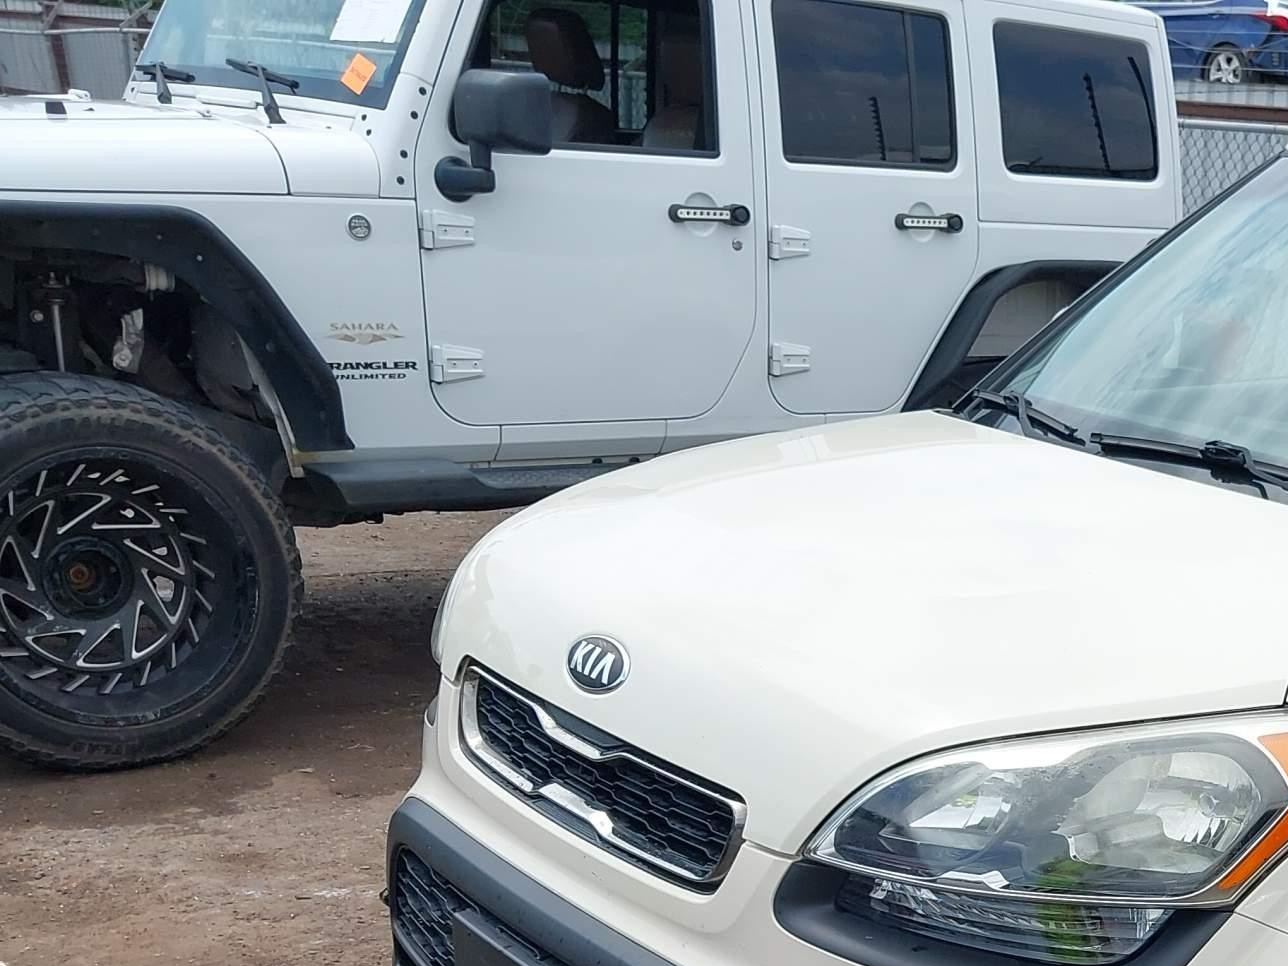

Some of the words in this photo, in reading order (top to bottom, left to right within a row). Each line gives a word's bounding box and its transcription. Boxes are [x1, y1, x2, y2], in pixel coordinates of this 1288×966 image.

[329, 322, 399, 331] SAHARA
[328, 361, 418, 370] RANGLER
[569, 640, 616, 686] KIA
